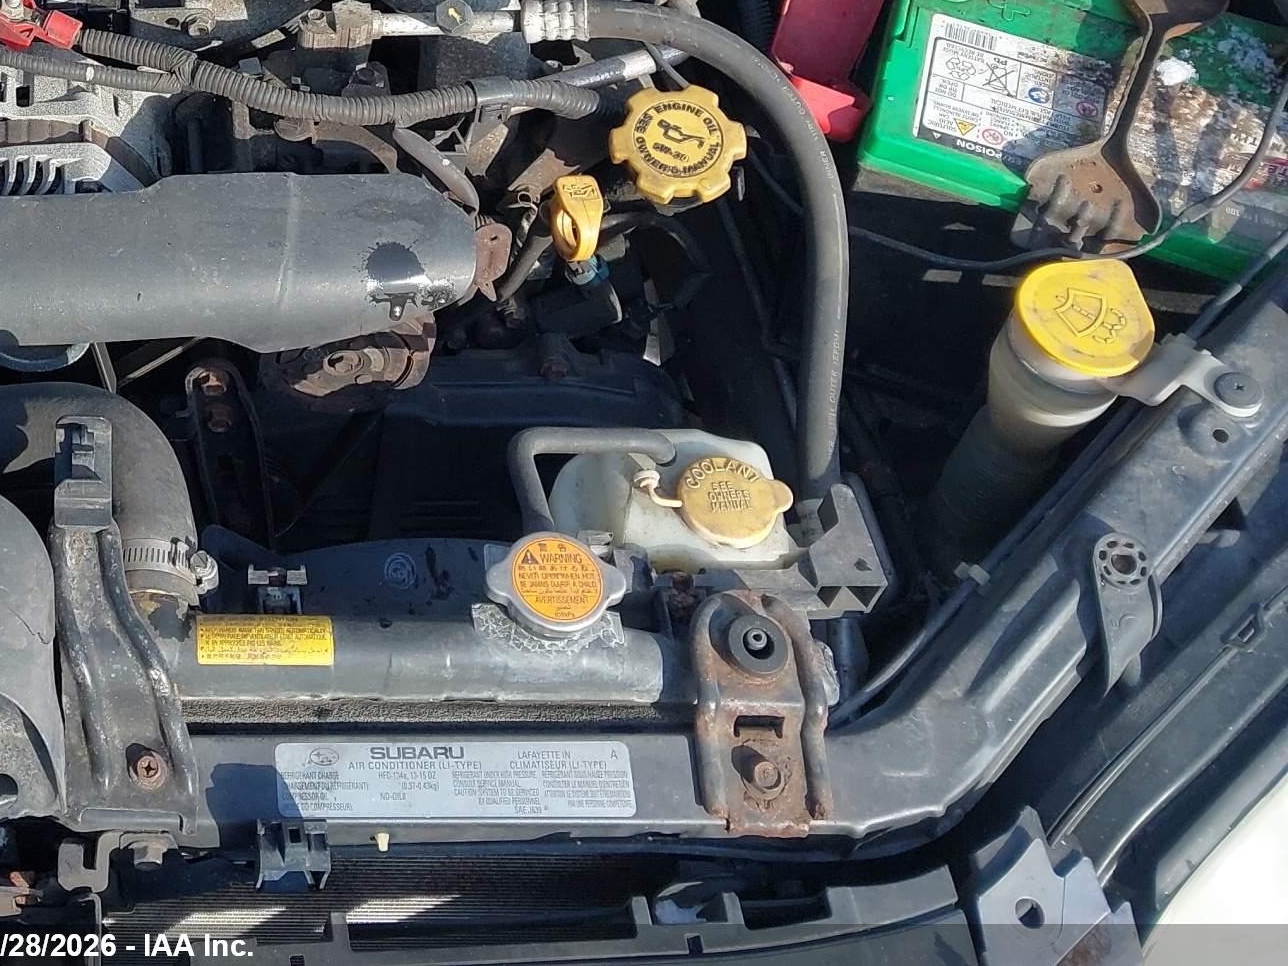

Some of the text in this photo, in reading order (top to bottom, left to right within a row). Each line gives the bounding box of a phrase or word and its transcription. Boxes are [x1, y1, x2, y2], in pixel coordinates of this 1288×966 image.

[653, 101, 719, 136] ENGINE OIL
[635, 111, 654, 134] SEE
[681, 141, 722, 175] MANUAL
[652, 142, 690, 163] 5W-30
[685, 459, 760, 489] COOLANT
[712, 481, 735, 492] SEE
[708, 491, 750, 503] OWNERS
[711, 502, 752, 514] MANUAL
[540, 553, 583, 564] WARNING
[518, 572, 539, 580] NEVER
[535, 594, 589, 604] AVERTISSEMENT
[370, 745, 465, 760] SUBARU
[518, 749, 571, 760] LAFAYETTE IN
[610, 749, 618, 760] A
[348, 761, 482, 771] AIR CONDITIONER (LI-TYPE)
[509, 760, 607, 771] CLIMATISEUR (LI-TYPE)
